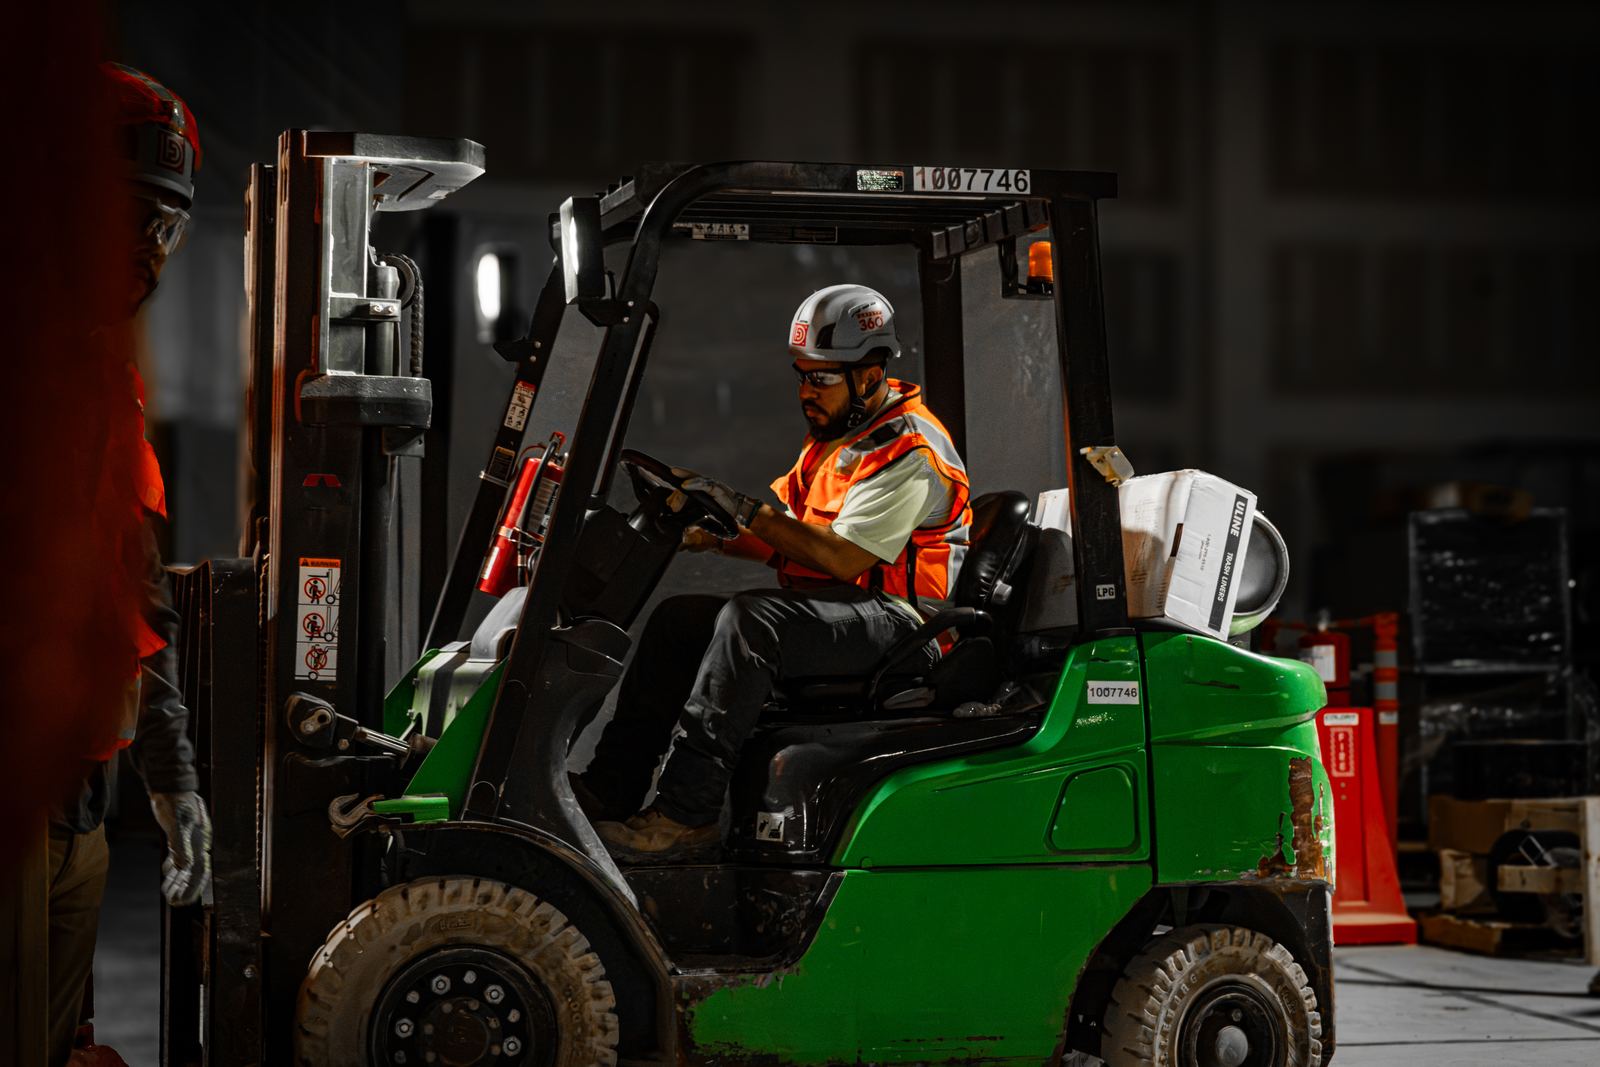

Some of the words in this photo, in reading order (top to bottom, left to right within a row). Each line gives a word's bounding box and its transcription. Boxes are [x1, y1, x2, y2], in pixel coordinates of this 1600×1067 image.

[915, 167, 1029, 193] 1007746
[858, 315, 884, 332] 360
[1230, 502, 1246, 538] ULINE
[1223, 552, 1234, 576] TRASH
[1096, 587, 1115, 598] LPG
[1217, 576, 1229, 602] LINERS
[1089, 687, 1138, 698] 1007746
